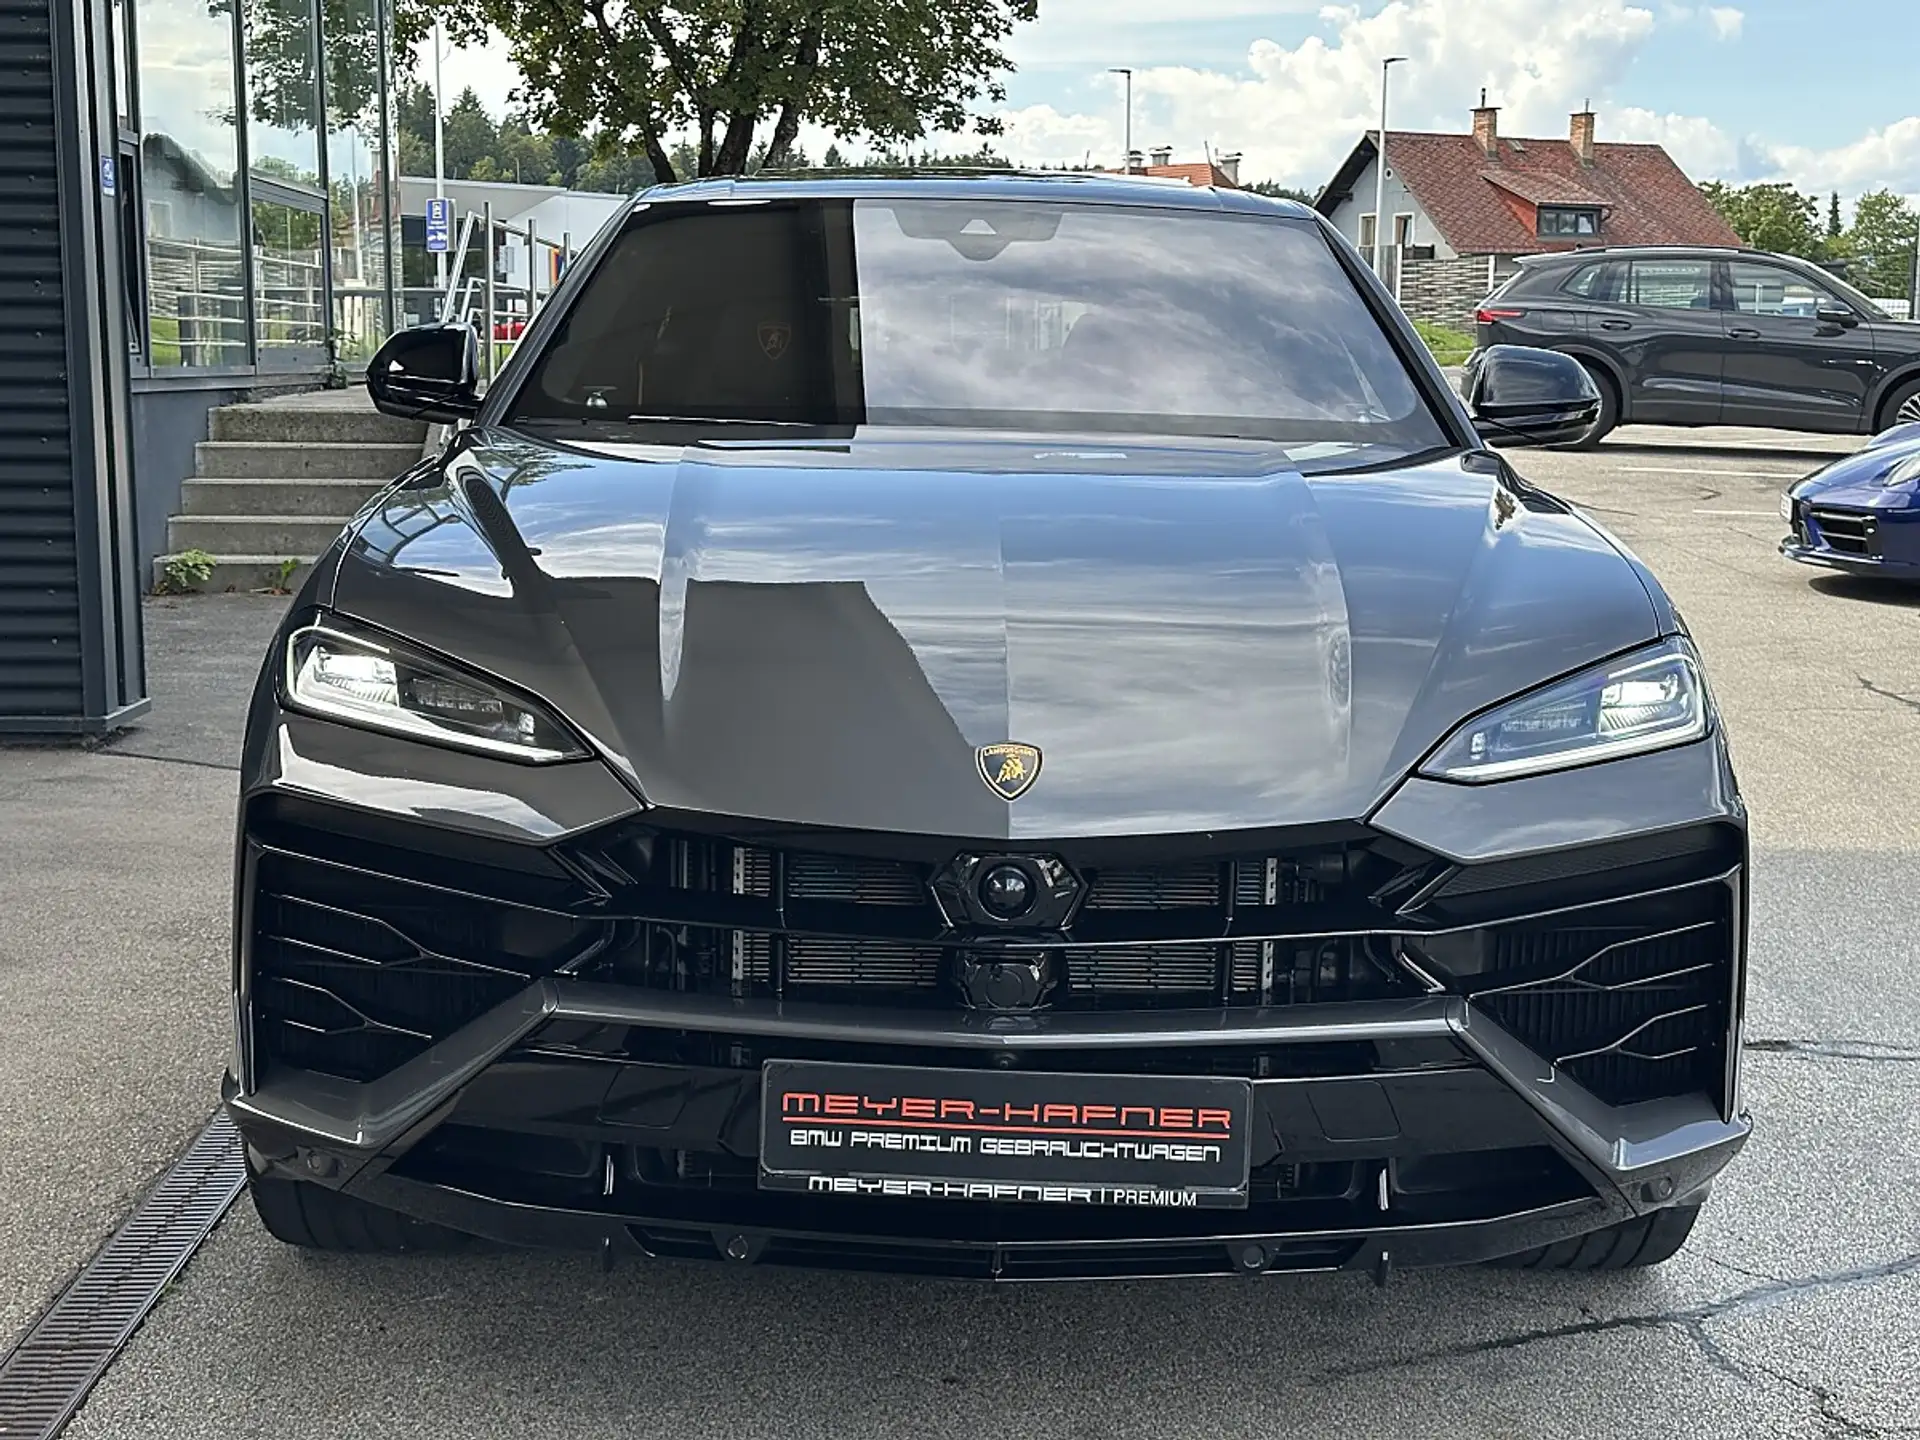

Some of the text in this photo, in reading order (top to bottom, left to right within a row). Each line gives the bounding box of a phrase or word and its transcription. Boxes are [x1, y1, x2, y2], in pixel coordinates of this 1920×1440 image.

[782, 1092, 1232, 1129] MEYER-HAFNER
[790, 1129, 1220, 1163] BMW PREMIUM GEBRAUCHTWAGEN
[808, 1176, 1092, 1203] MEYER-HAFNER
[1113, 1189, 1197, 1206] PREMIUM
